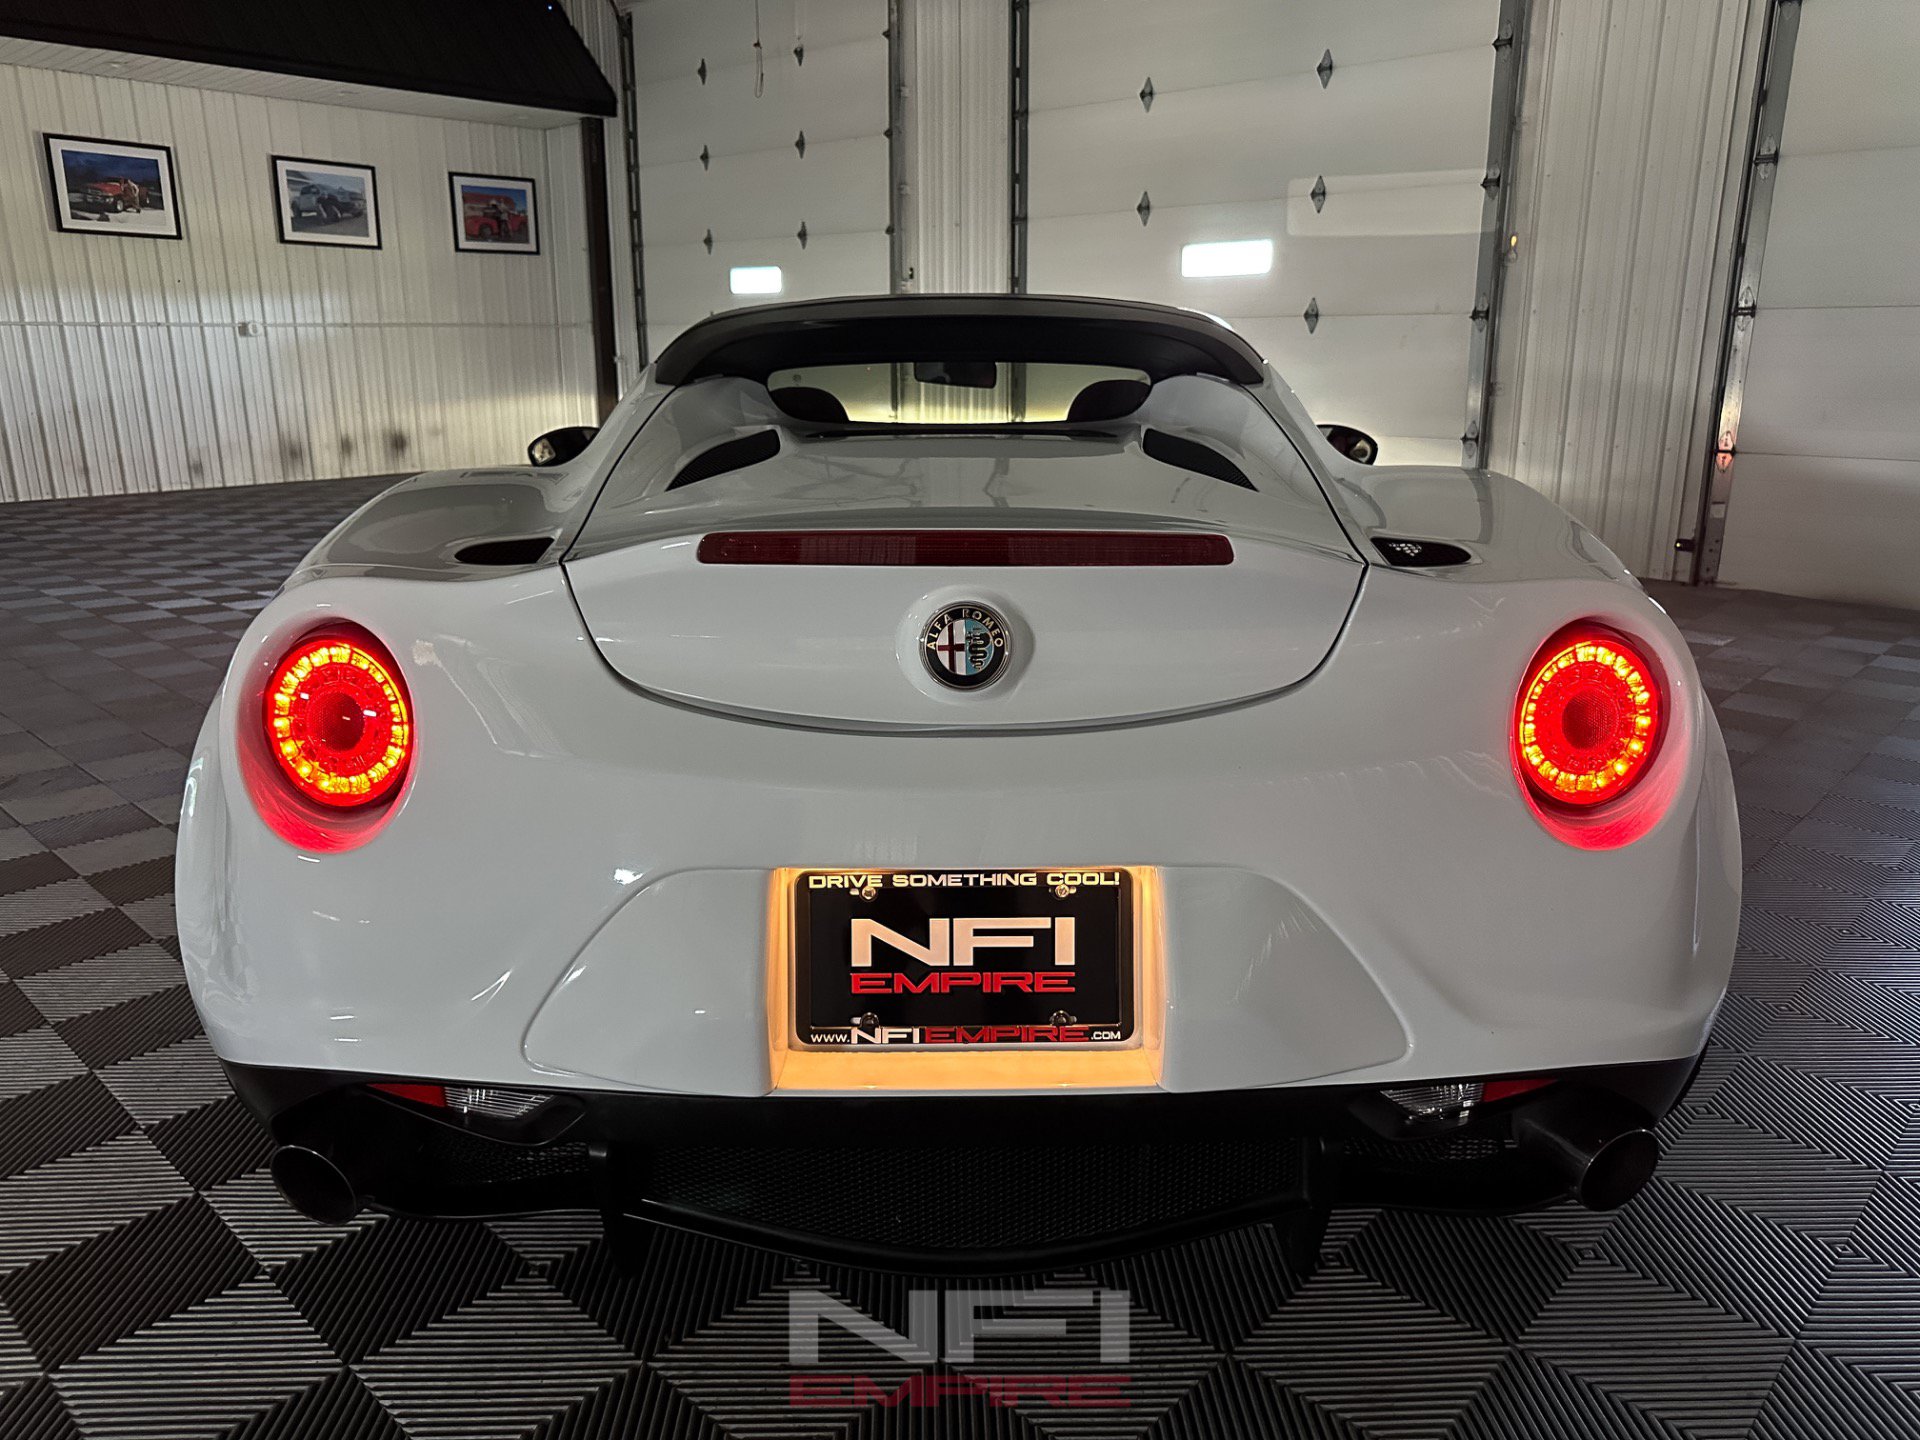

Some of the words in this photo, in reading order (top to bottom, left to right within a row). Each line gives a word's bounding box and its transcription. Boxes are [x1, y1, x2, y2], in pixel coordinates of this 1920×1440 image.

[926, 613, 953, 650] ALFA
[962, 608, 1004, 647] ROMEO
[809, 874, 883, 889] DRIVE
[892, 873, 1037, 887] SOMETHING
[1046, 872, 1120, 887] COOL!
[850, 917, 1076, 967] NFI
[850, 971, 1076, 994] EMPIRE
